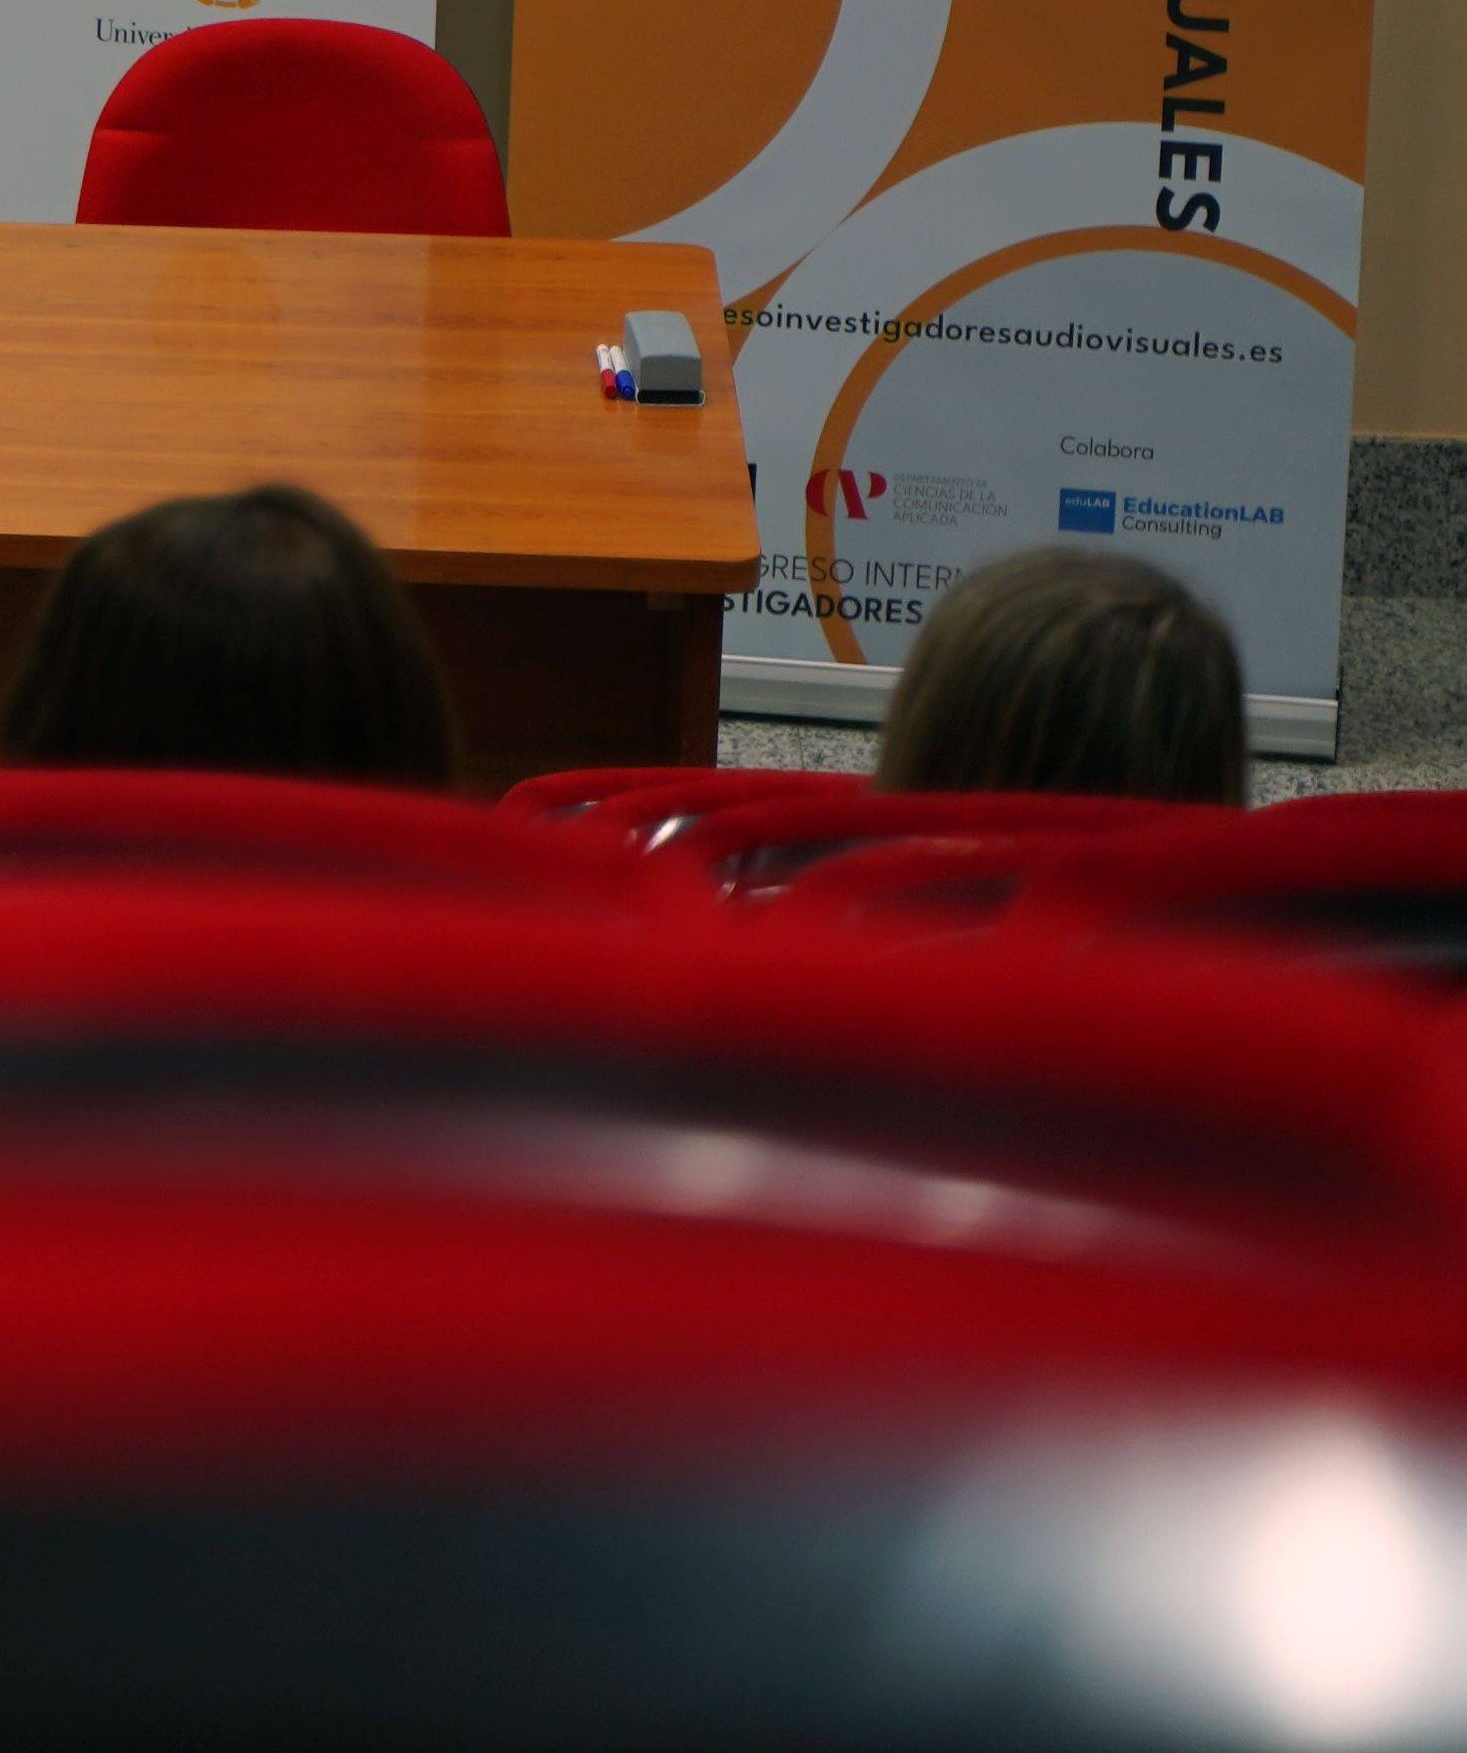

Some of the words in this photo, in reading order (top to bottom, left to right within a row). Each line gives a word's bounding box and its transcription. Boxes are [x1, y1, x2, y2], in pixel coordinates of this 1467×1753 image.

[723, 304, 1284, 365] esoinvestigadoresaudiovisuales.es
[1060, 436, 1155, 461] Colabora
[894, 485, 957, 500] CIENCIAS
[959, 489, 976, 501] DE
[979, 491, 997, 502] LA
[1065, 495, 1111, 509] eduLAB
[892, 511, 959, 527] APLICADA
[893, 497, 1009, 517] COMUNICACIÓN
[1123, 496, 1285, 526] EducationLAB
[1121, 516, 1223, 540] Consulting
[722, 590, 924, 626] STIGADORES
